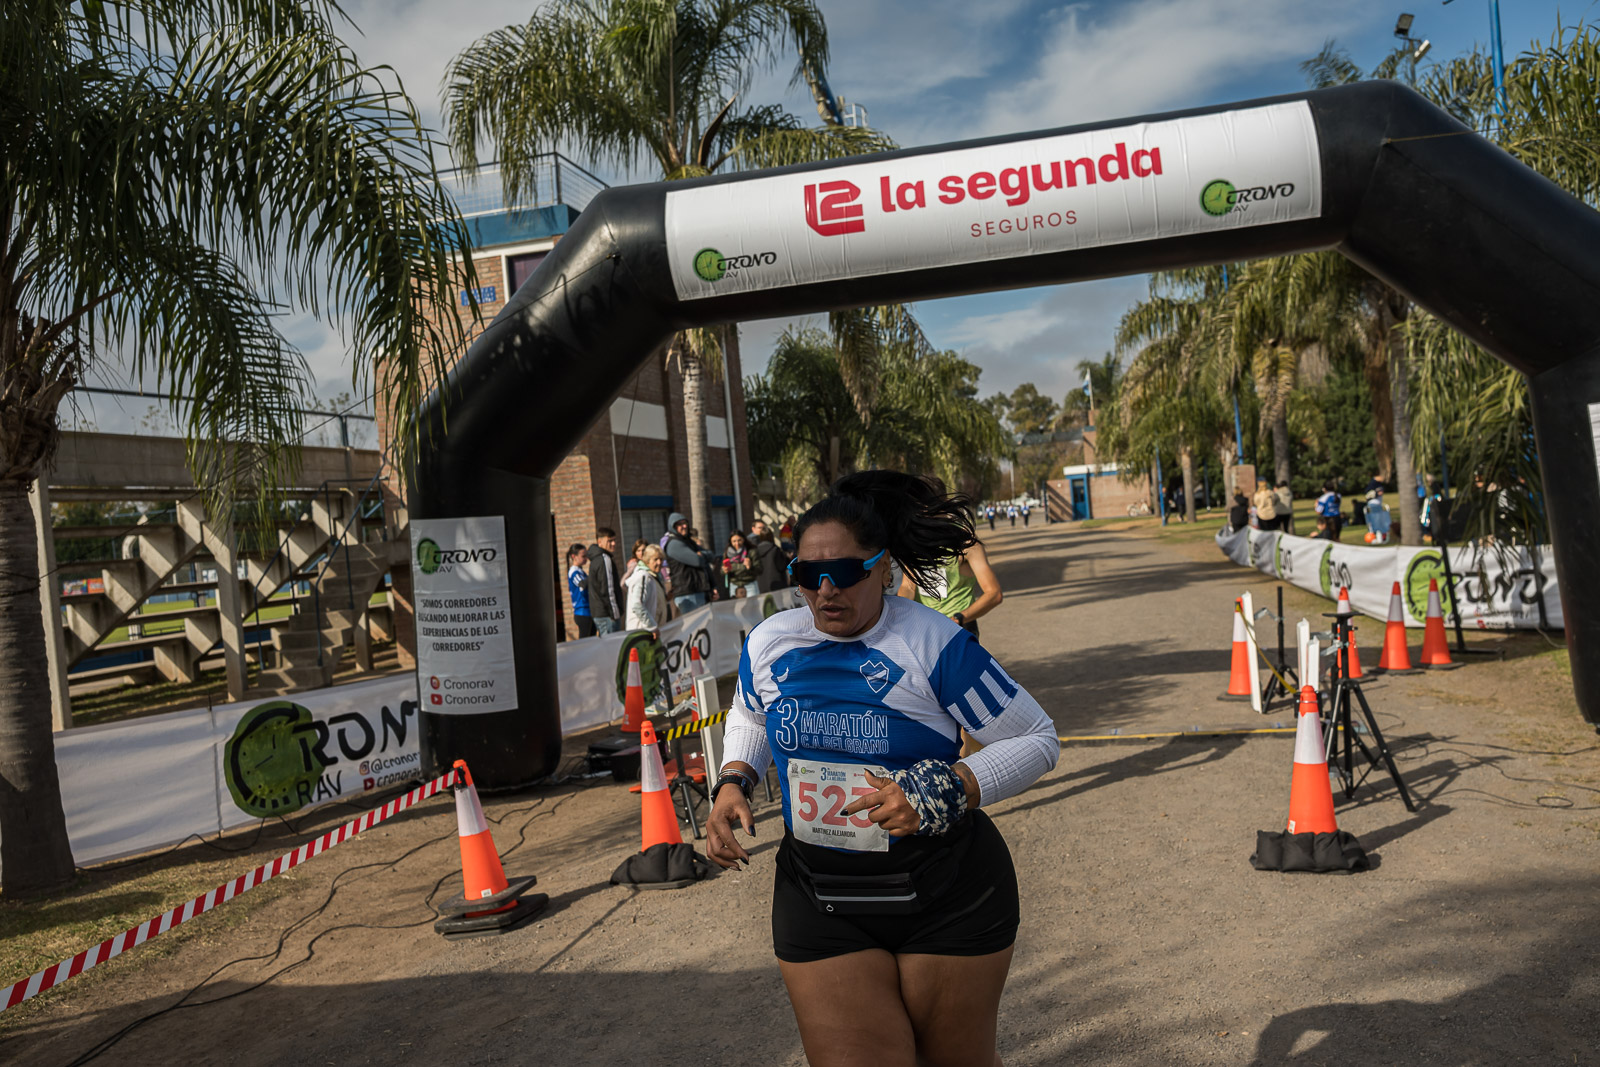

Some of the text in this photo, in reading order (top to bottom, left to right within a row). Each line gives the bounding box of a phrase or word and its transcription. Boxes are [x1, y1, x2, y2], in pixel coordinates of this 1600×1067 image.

[880, 141, 1164, 213] la segunda
[1226, 182, 1295, 205] CRONO
[1224, 203, 1250, 214] RAV
[970, 210, 1078, 238] SEGUROS
[717, 251, 777, 272] CRONO
[717, 270, 739, 279] RAV
[433, 548, 497, 565] CRONO
[432, 565, 453, 574] RAV
[443, 596, 498, 609] CORREDORES
[449, 611, 489, 623] MEJORAR
[490, 610, 506, 621] LAS
[422, 625, 499, 638] EXPERIENCIAS DE LOS
[443, 679, 495, 690] Cronorav
[444, 694, 496, 706] Cronorav
[775, 697, 799, 752] 3
[800, 710, 889, 738] MARATÓN
[297, 770, 342, 806] RAV
[811, 826, 856, 838] MARTINEZ ALEJANDRA
